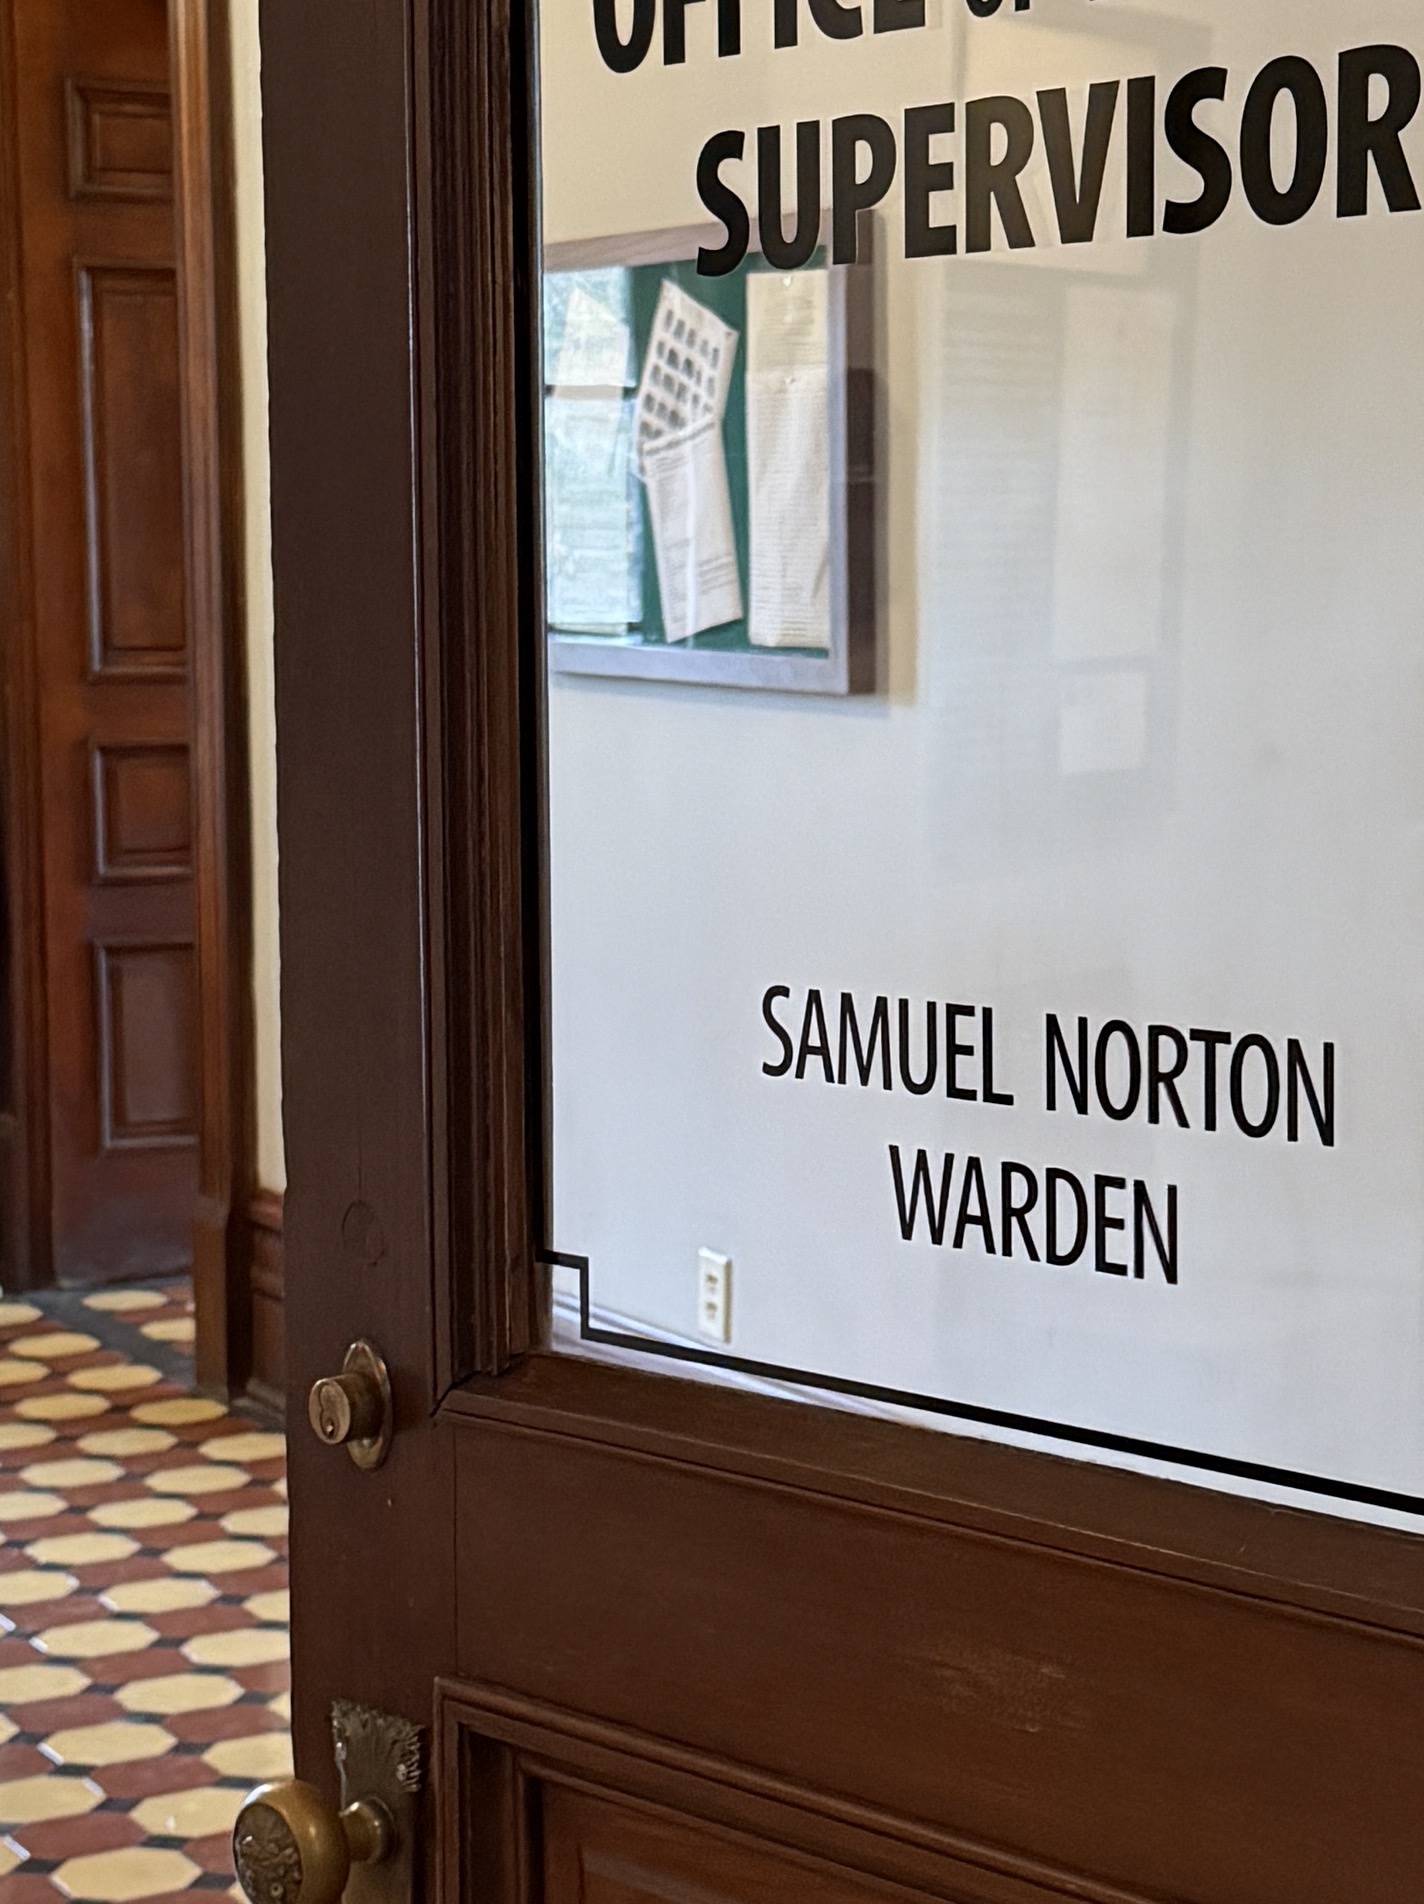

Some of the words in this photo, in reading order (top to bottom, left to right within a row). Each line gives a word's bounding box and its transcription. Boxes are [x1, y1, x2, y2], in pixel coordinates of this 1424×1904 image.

[694, 43, 1423, 279] SUPERVISOR
[761, 984, 1015, 1107] SAMUEL
[1044, 1012, 1336, 1149] NORTON
[887, 1143, 1179, 1286] WARDEN
